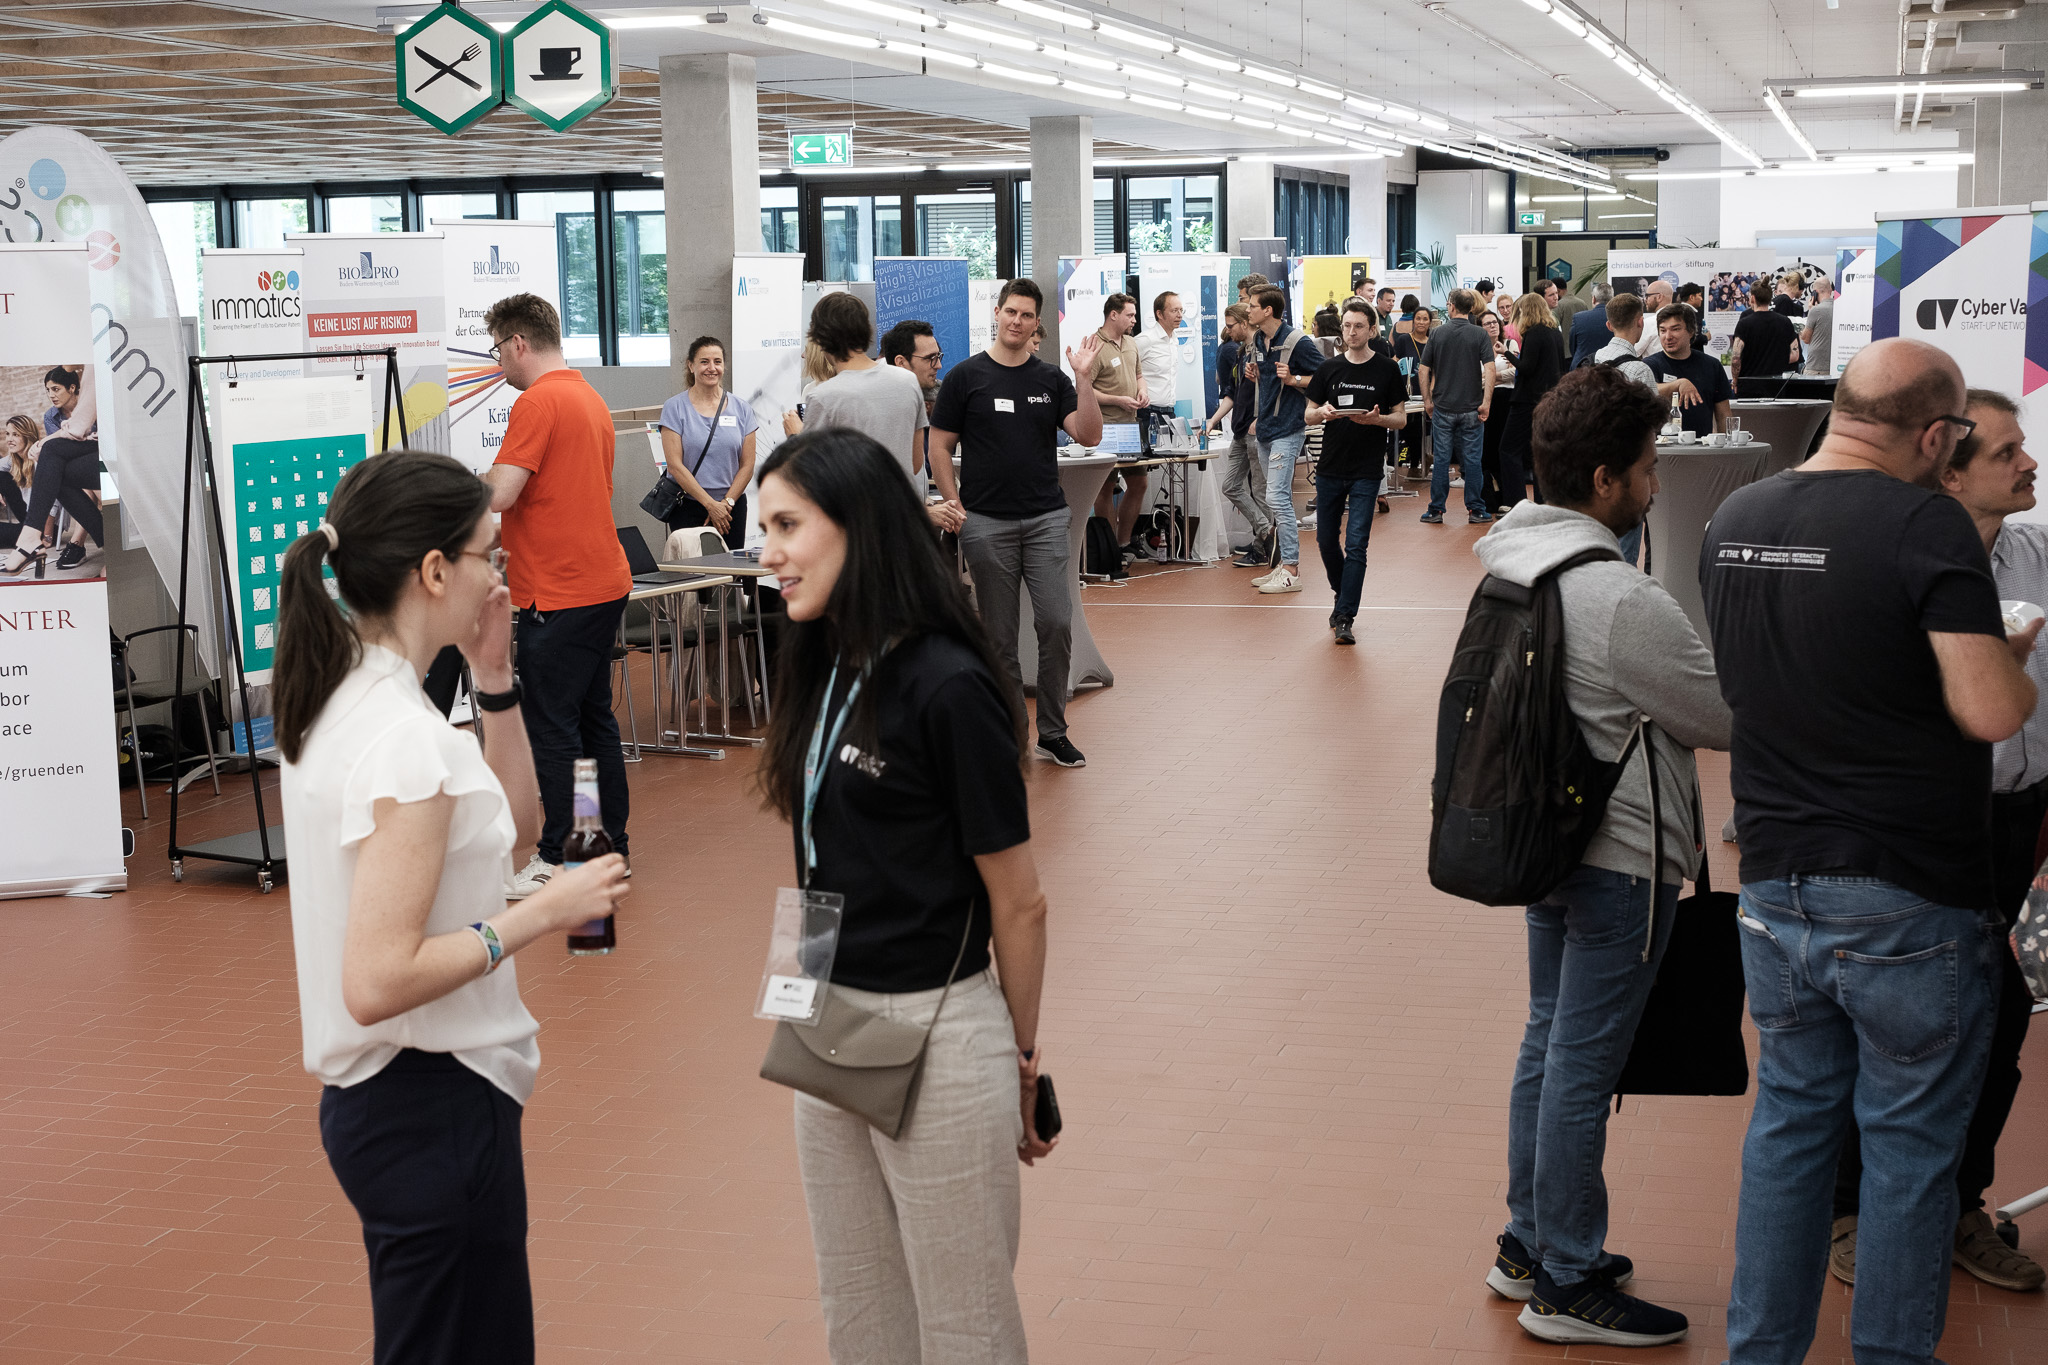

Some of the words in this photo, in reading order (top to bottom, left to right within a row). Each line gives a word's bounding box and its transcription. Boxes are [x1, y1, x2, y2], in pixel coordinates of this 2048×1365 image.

[1611, 261, 1644, 269] christian
[1644, 260, 1672, 269] bürkert
[1685, 260, 1714, 269] stiftung
[880, 272, 906, 289] High
[882, 279, 965, 310] Visualization
[212, 292, 301, 320] immatics
[459, 307, 485, 318] Partner
[878, 304, 918, 320] Humanities
[1961, 298, 2007, 319] Cyber
[314, 318, 339, 332] KEINE
[341, 317, 360, 331] LUST
[363, 316, 378, 330] AUF
[380, 315, 412, 329] RISIKO?
[456, 325, 467, 337] der
[1960, 321, 1997, 330] START-UP
[2, 722, 33, 736] ace
[0, 762, 85, 782] /gruenden
